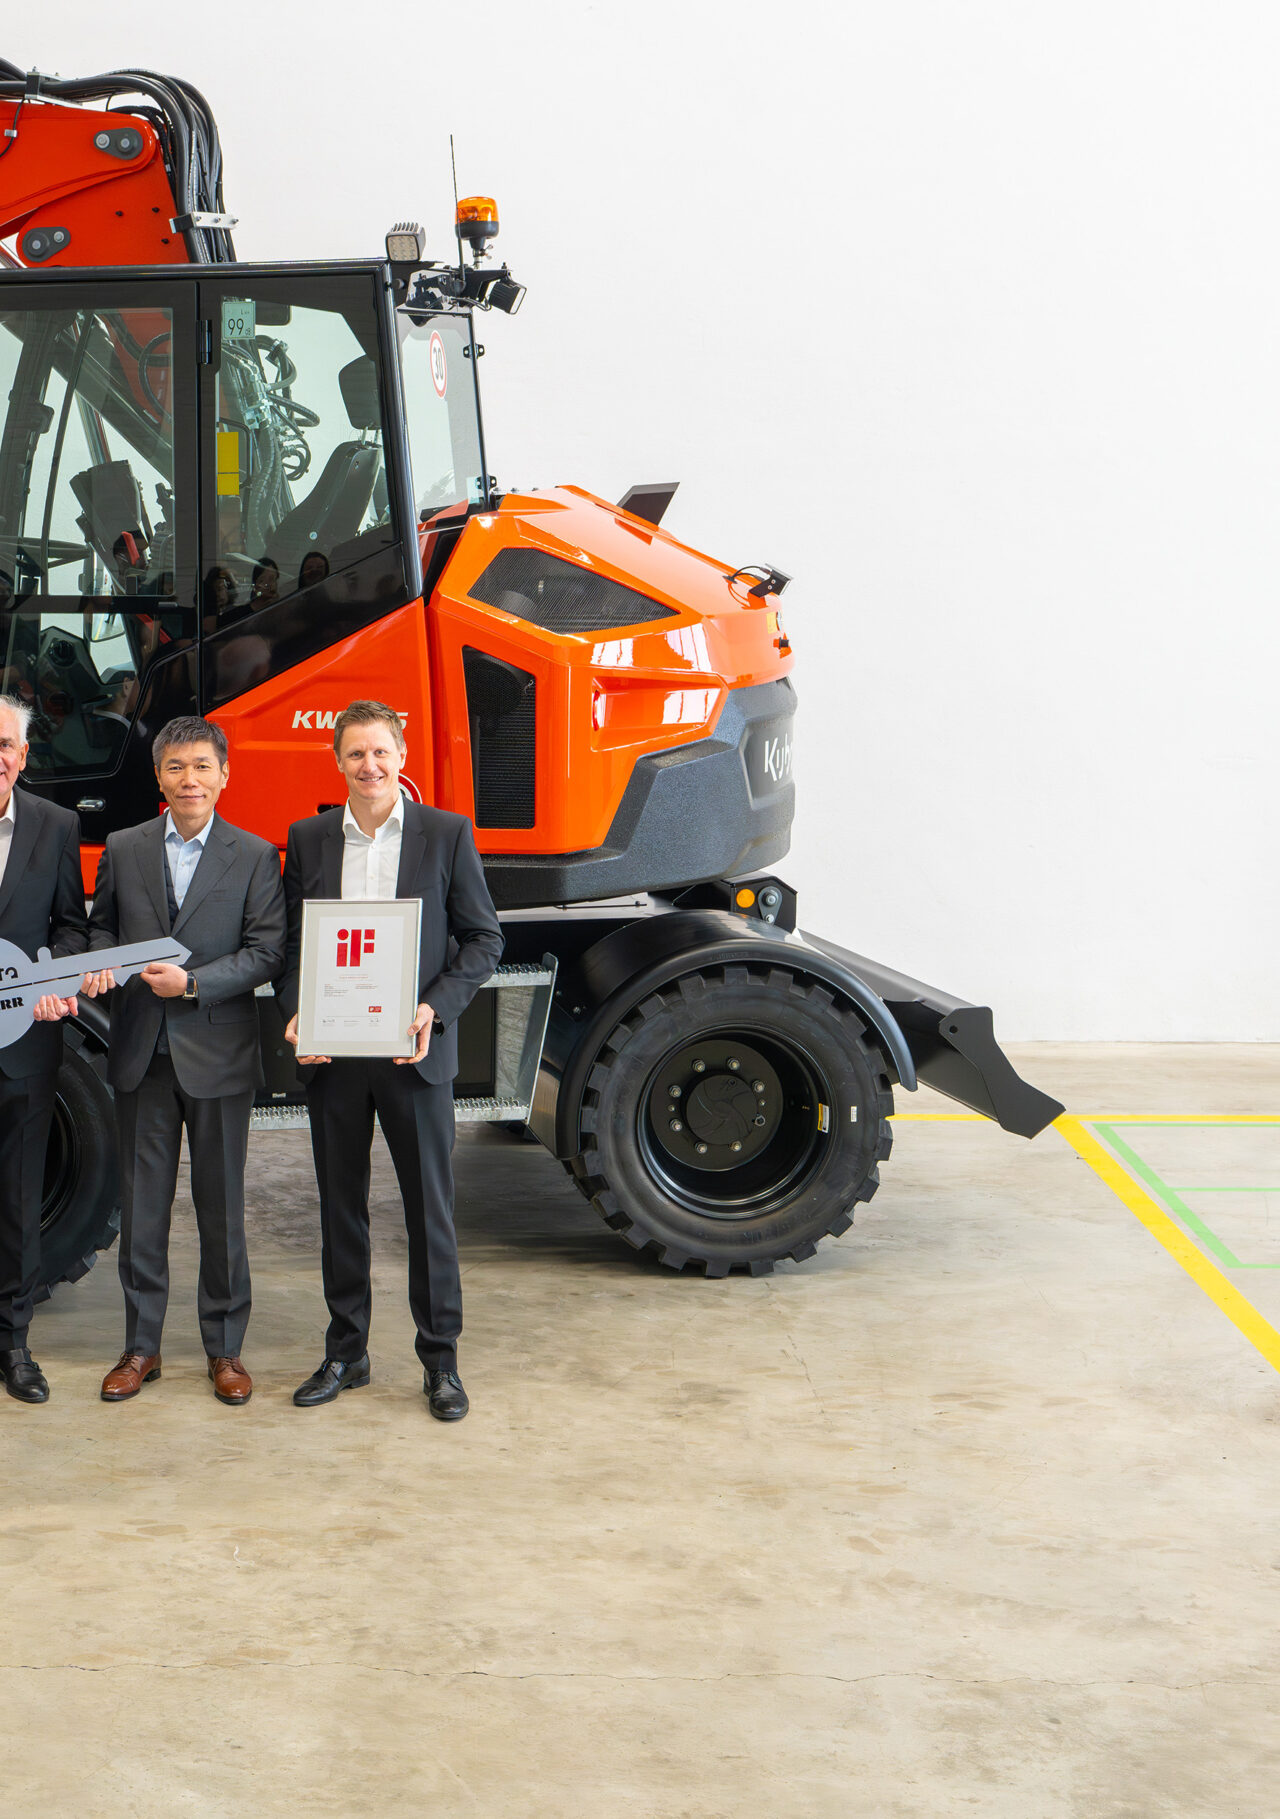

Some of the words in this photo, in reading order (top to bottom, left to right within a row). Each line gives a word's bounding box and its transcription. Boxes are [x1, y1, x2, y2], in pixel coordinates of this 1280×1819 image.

[227, 318, 244, 335] 99
[433, 346, 444, 380] 30
[291, 710, 408, 729] KW5
